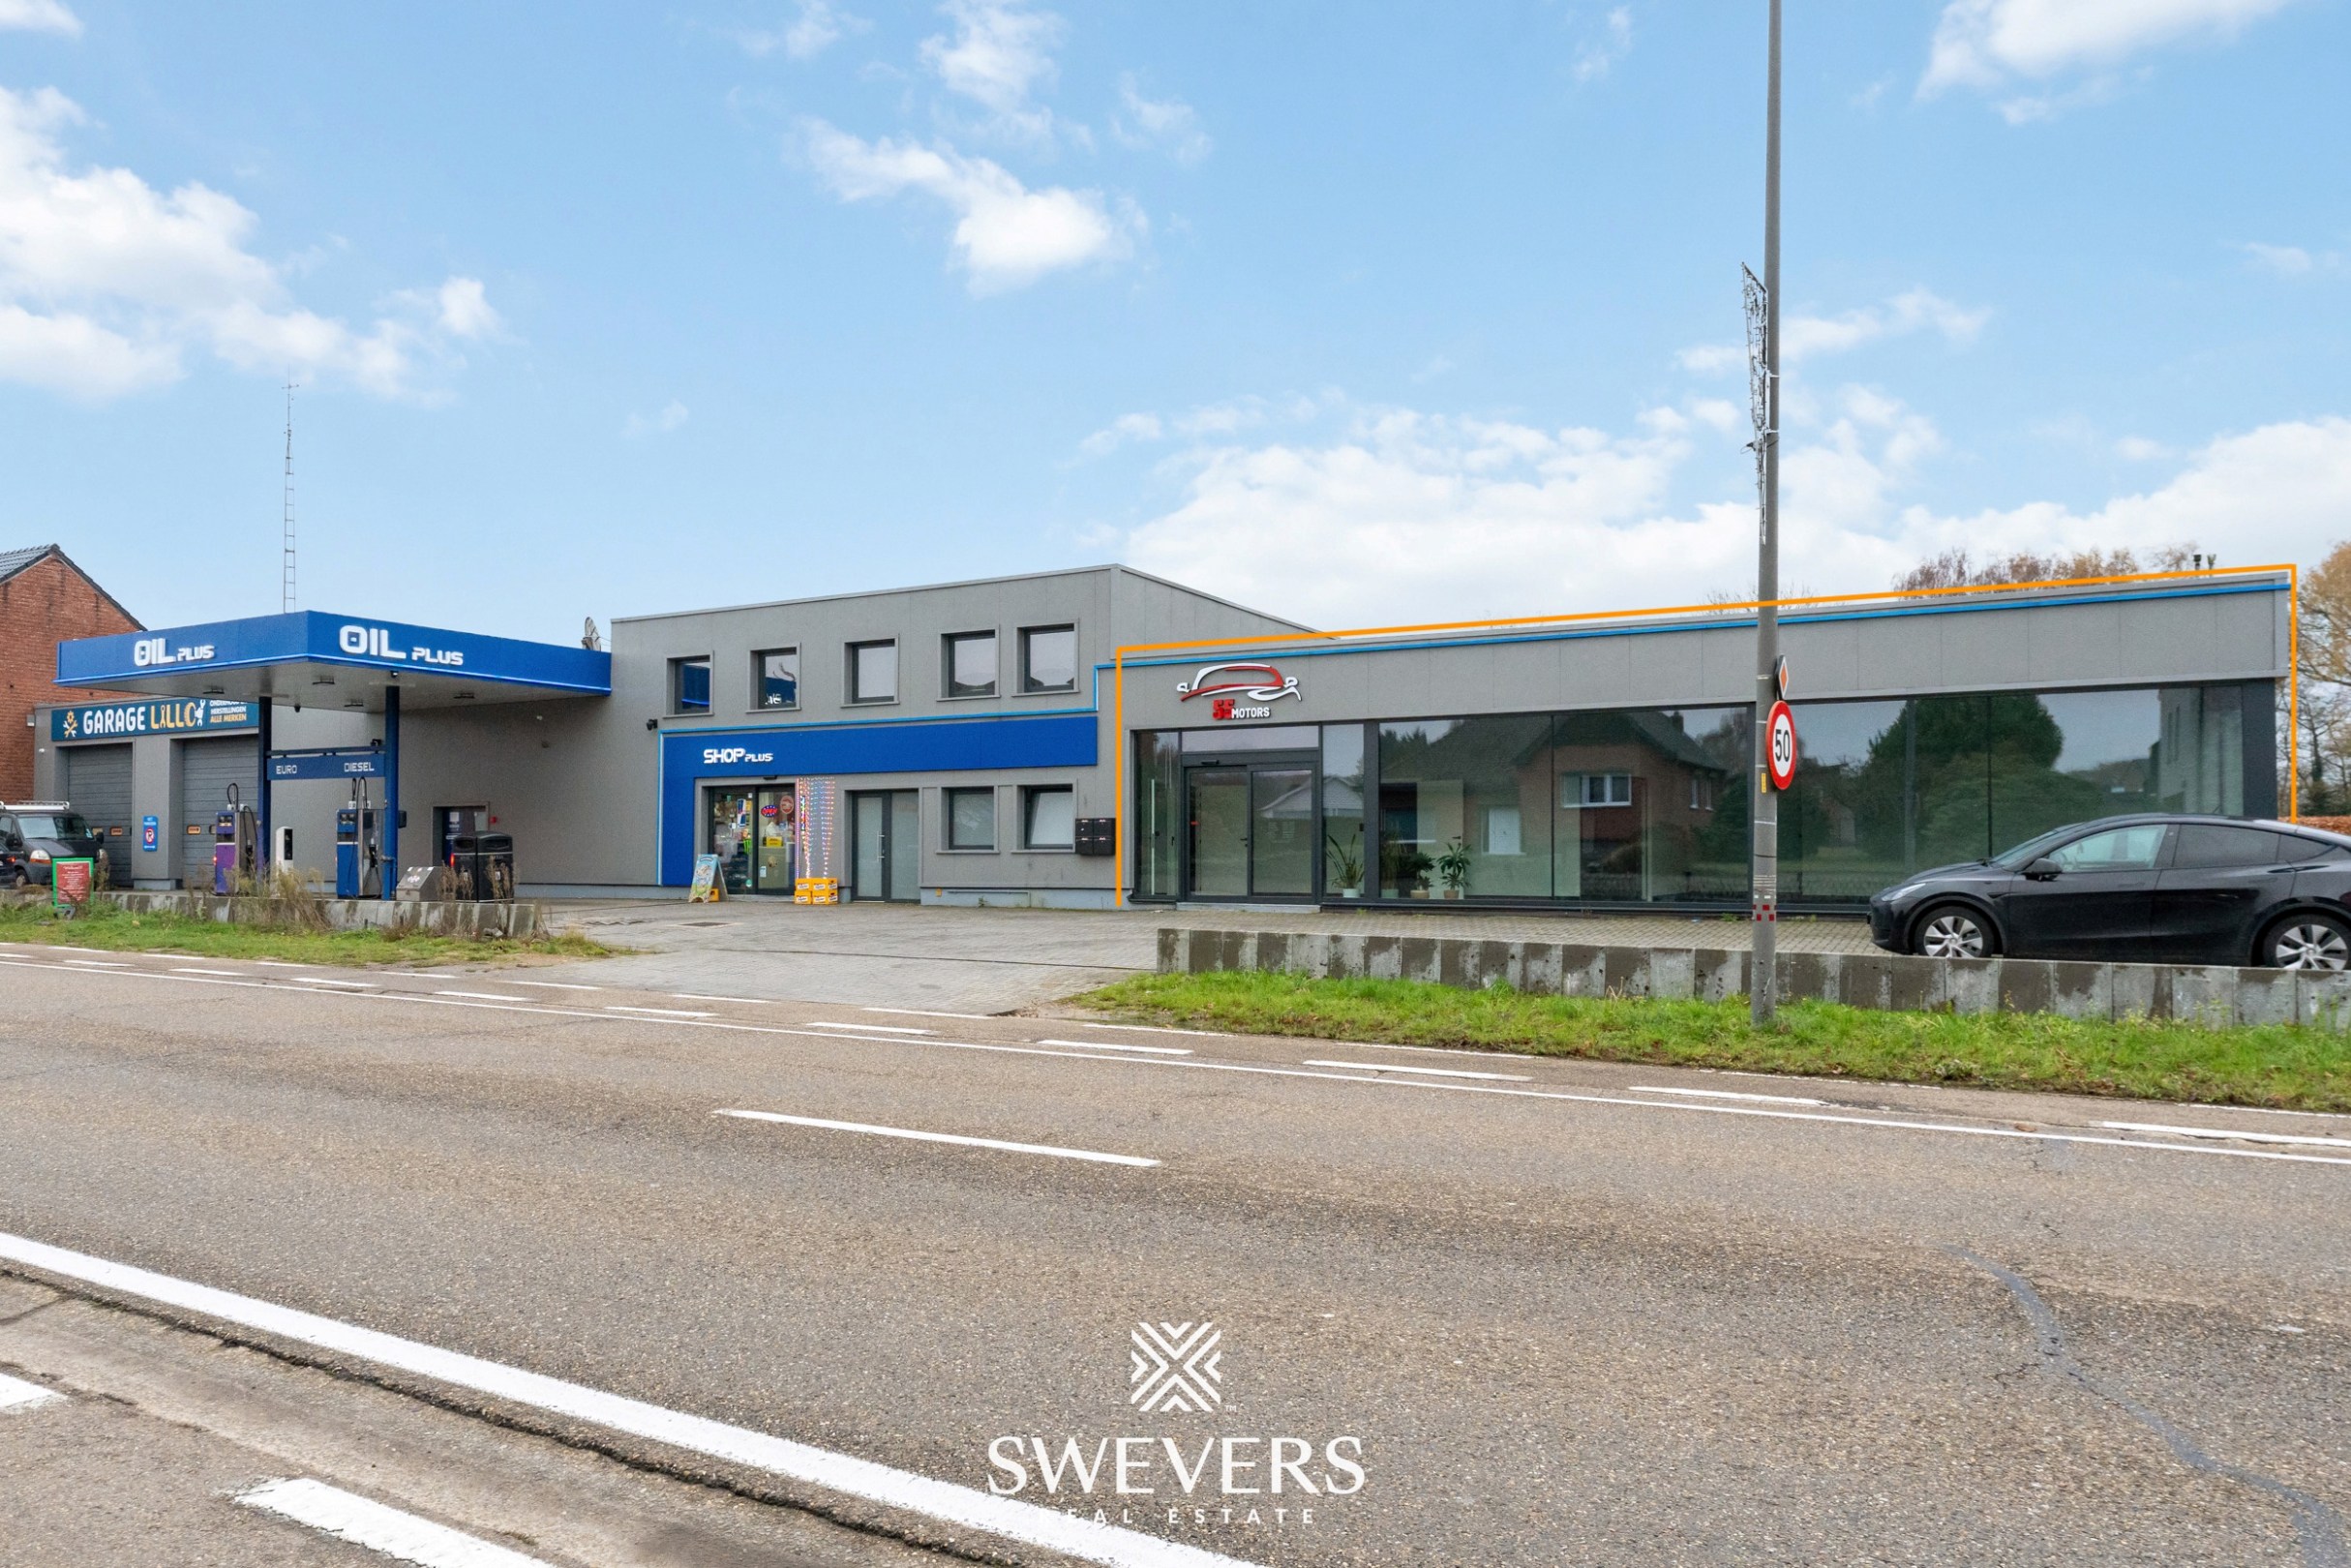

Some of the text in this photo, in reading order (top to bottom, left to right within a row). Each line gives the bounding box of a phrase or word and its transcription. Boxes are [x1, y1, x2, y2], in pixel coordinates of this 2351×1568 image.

[135, 638, 215, 667] OIL PLUS
[339, 624, 464, 666] OIL PLUS
[83, 707, 146, 735] GARAGE
[209, 713, 247, 723] ALLE MERKEN
[1231, 707, 1270, 719] MOTORS
[704, 747, 773, 764] SHOP PLUS
[1775, 728, 1791, 762] 50
[276, 762, 376, 774] EURO DIESEL
